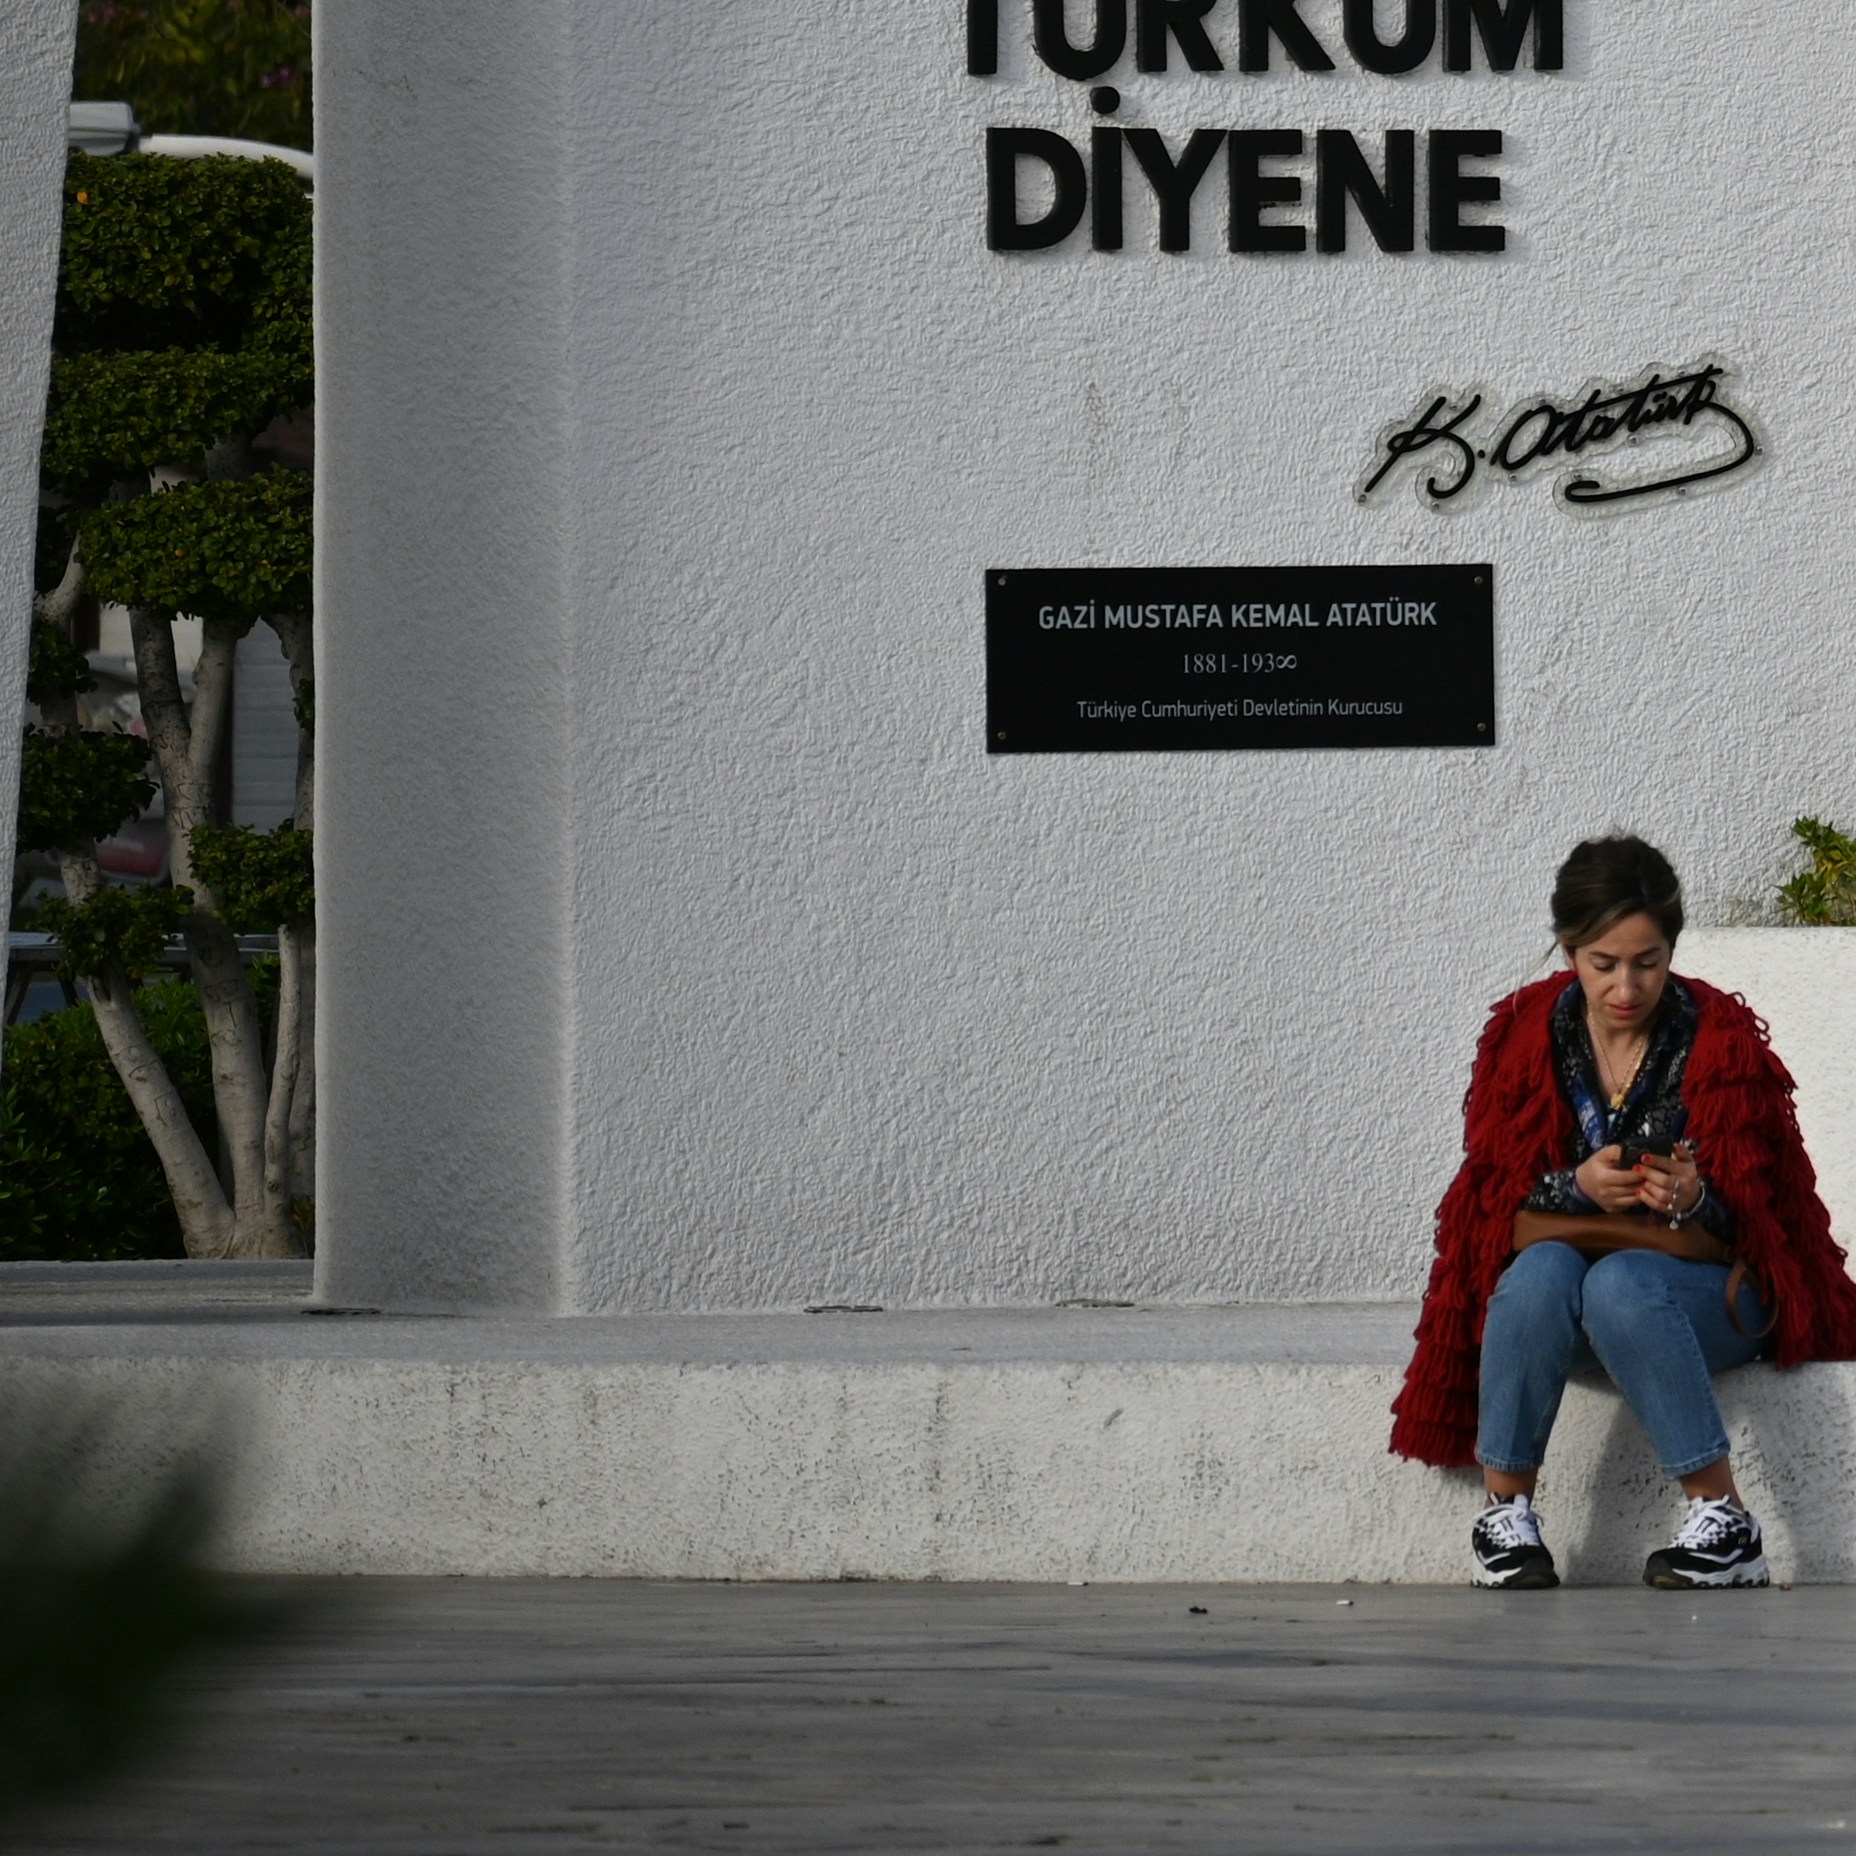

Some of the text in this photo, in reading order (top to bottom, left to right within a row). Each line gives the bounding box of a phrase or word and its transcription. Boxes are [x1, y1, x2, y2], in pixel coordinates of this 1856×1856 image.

[985, 85, 1507, 255] DİYENE
[1038, 595, 1438, 630] GAZİ MUSTAFA KEMAL ATATÜRK
[1076, 697, 1404, 723] Türkiye Cumhuriyeti Devletinin Kurucusu
